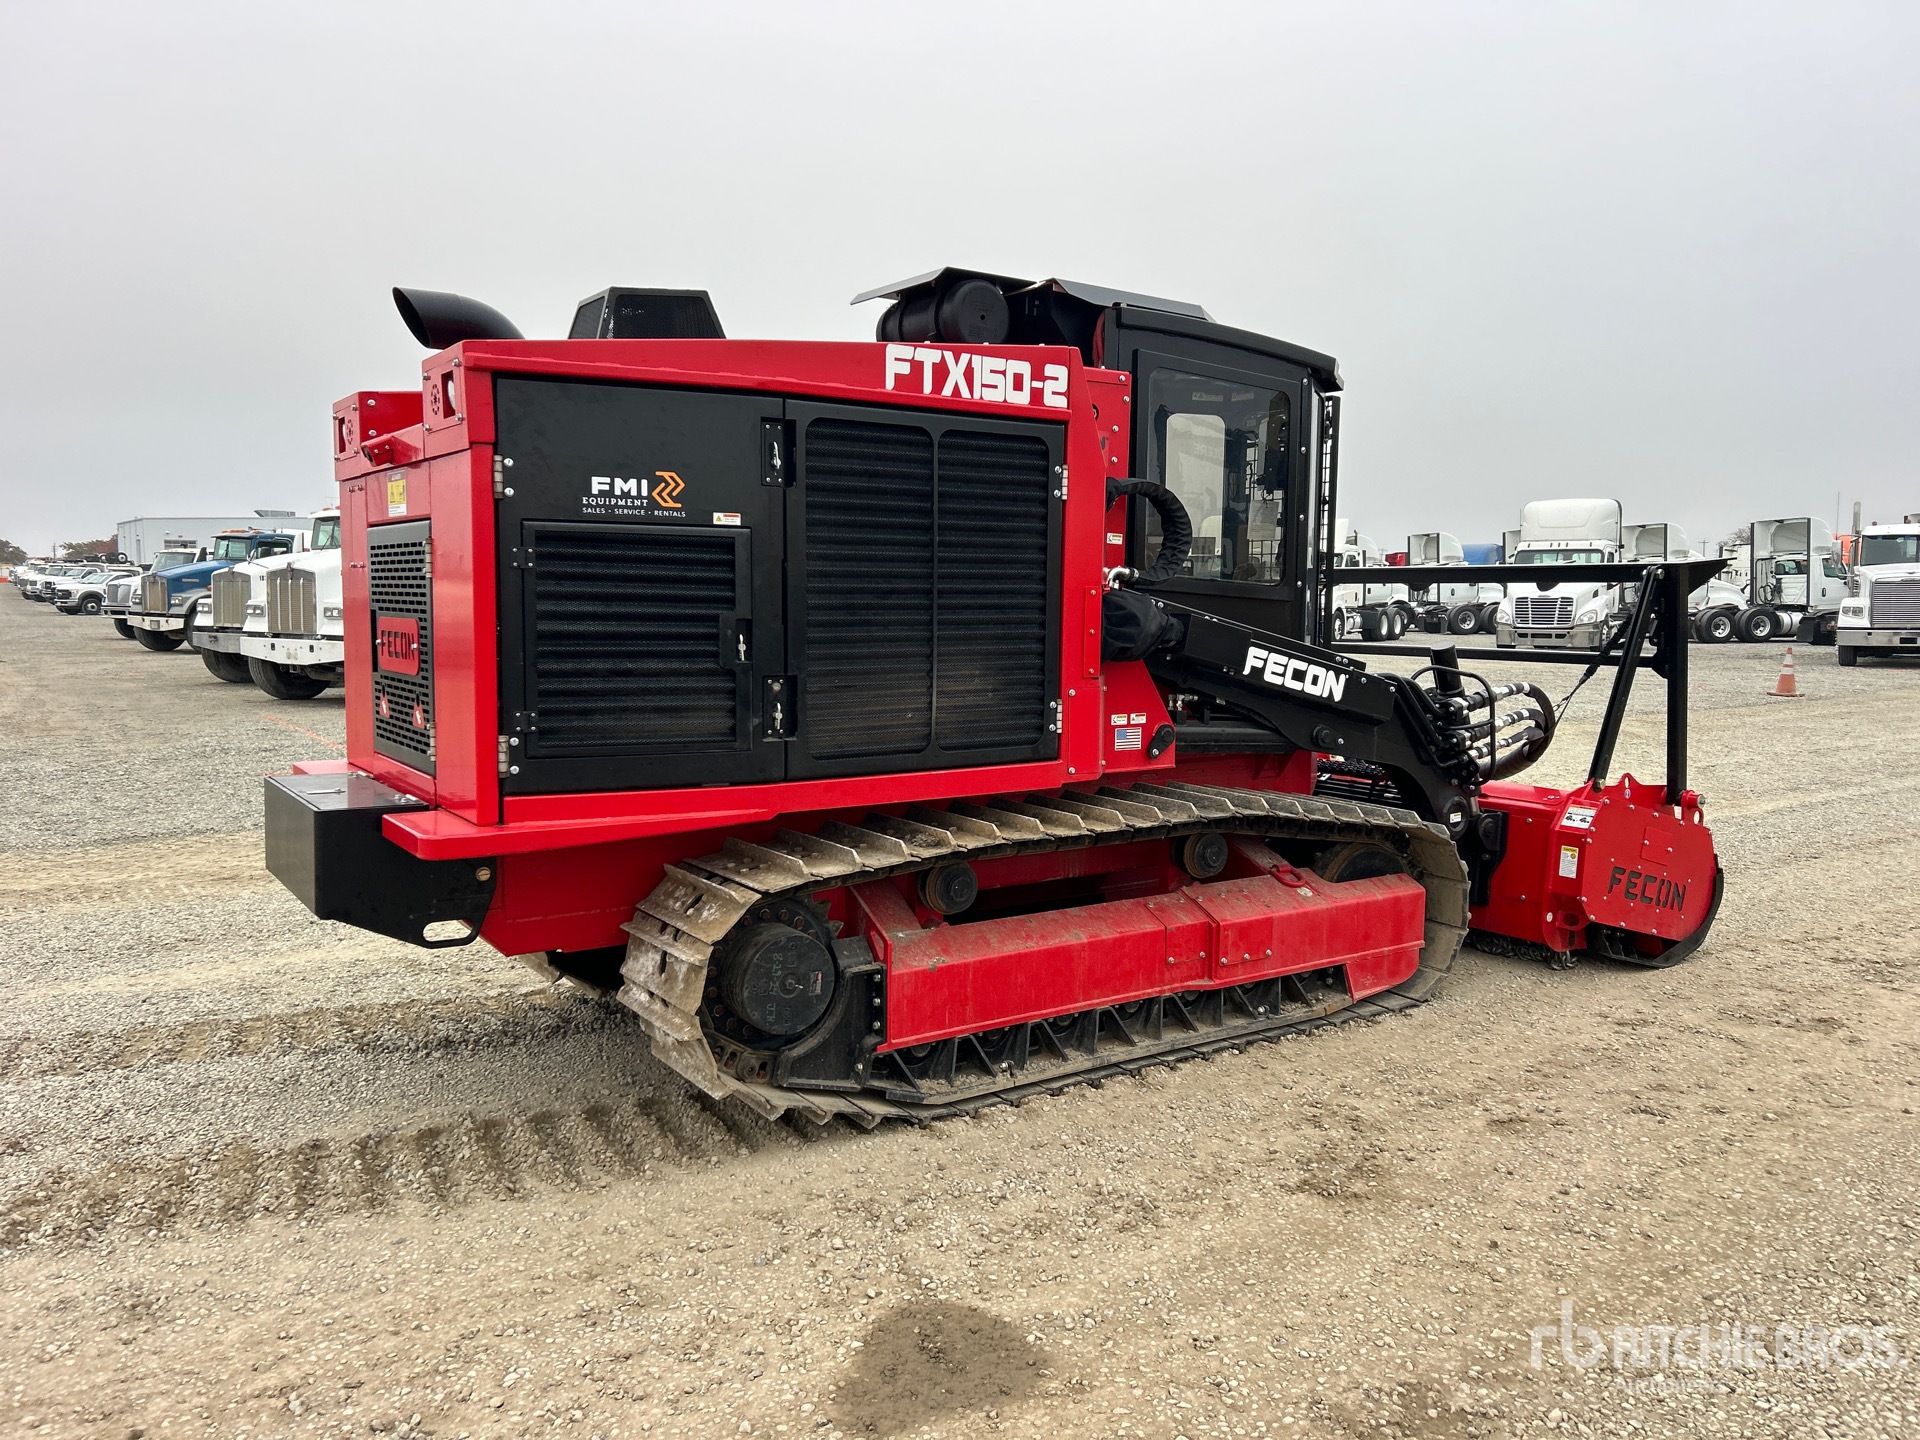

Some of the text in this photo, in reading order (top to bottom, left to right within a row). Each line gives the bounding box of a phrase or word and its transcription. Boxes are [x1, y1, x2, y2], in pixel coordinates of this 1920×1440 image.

[885, 343, 1068, 409] FTX150-2
[582, 497, 648, 507] EQUIPMENT
[591, 476, 648, 497] FMI
[614, 508, 645, 516] SERVICE
[654, 510, 686, 518] RENTALS
[381, 630, 415, 661] FECON
[1242, 646, 1346, 702] FECON
[1608, 866, 1686, 912] FECON
